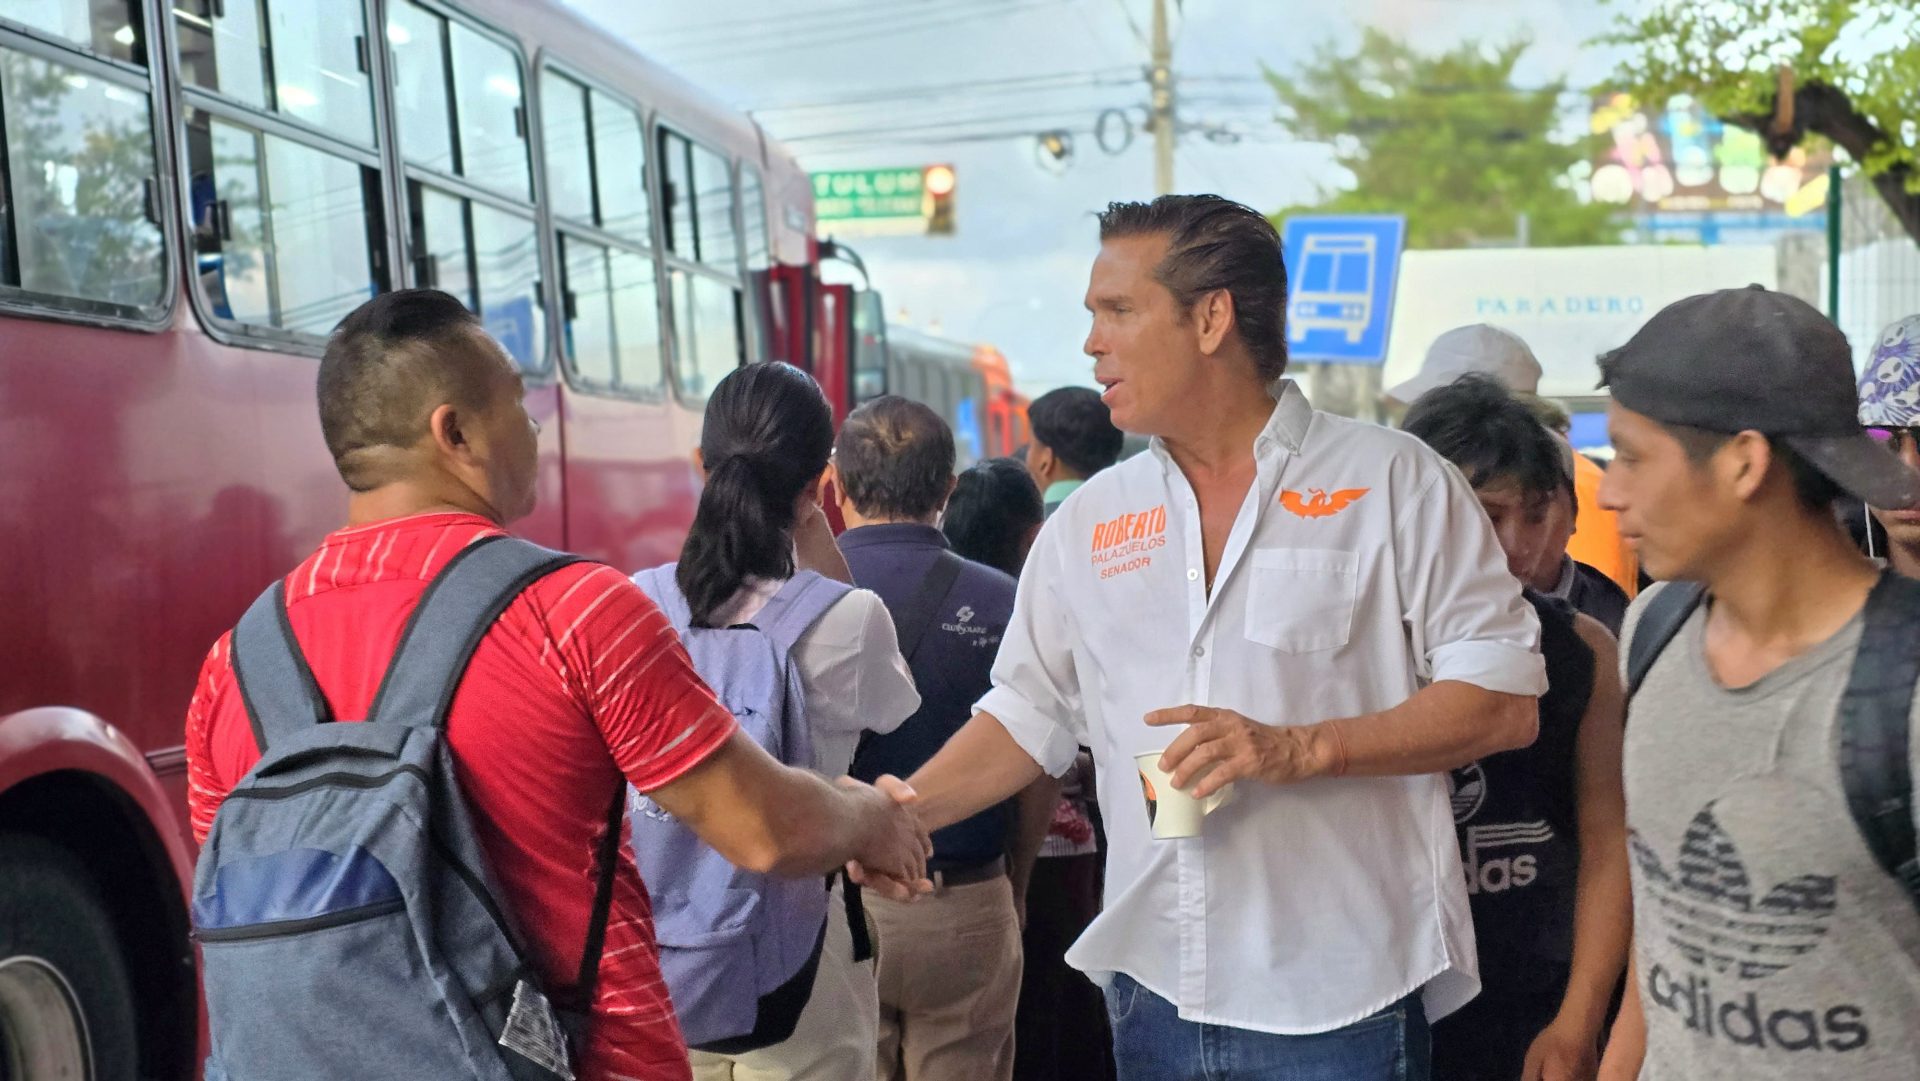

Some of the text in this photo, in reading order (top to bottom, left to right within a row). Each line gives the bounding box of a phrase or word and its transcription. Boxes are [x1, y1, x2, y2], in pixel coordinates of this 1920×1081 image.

[1475, 295, 1644, 315] PARADERO
[1091, 504, 1167, 552] ROBERTO
[1090, 535, 1167, 567] PALAZUELOS
[1100, 556, 1152, 580] SENADOR
